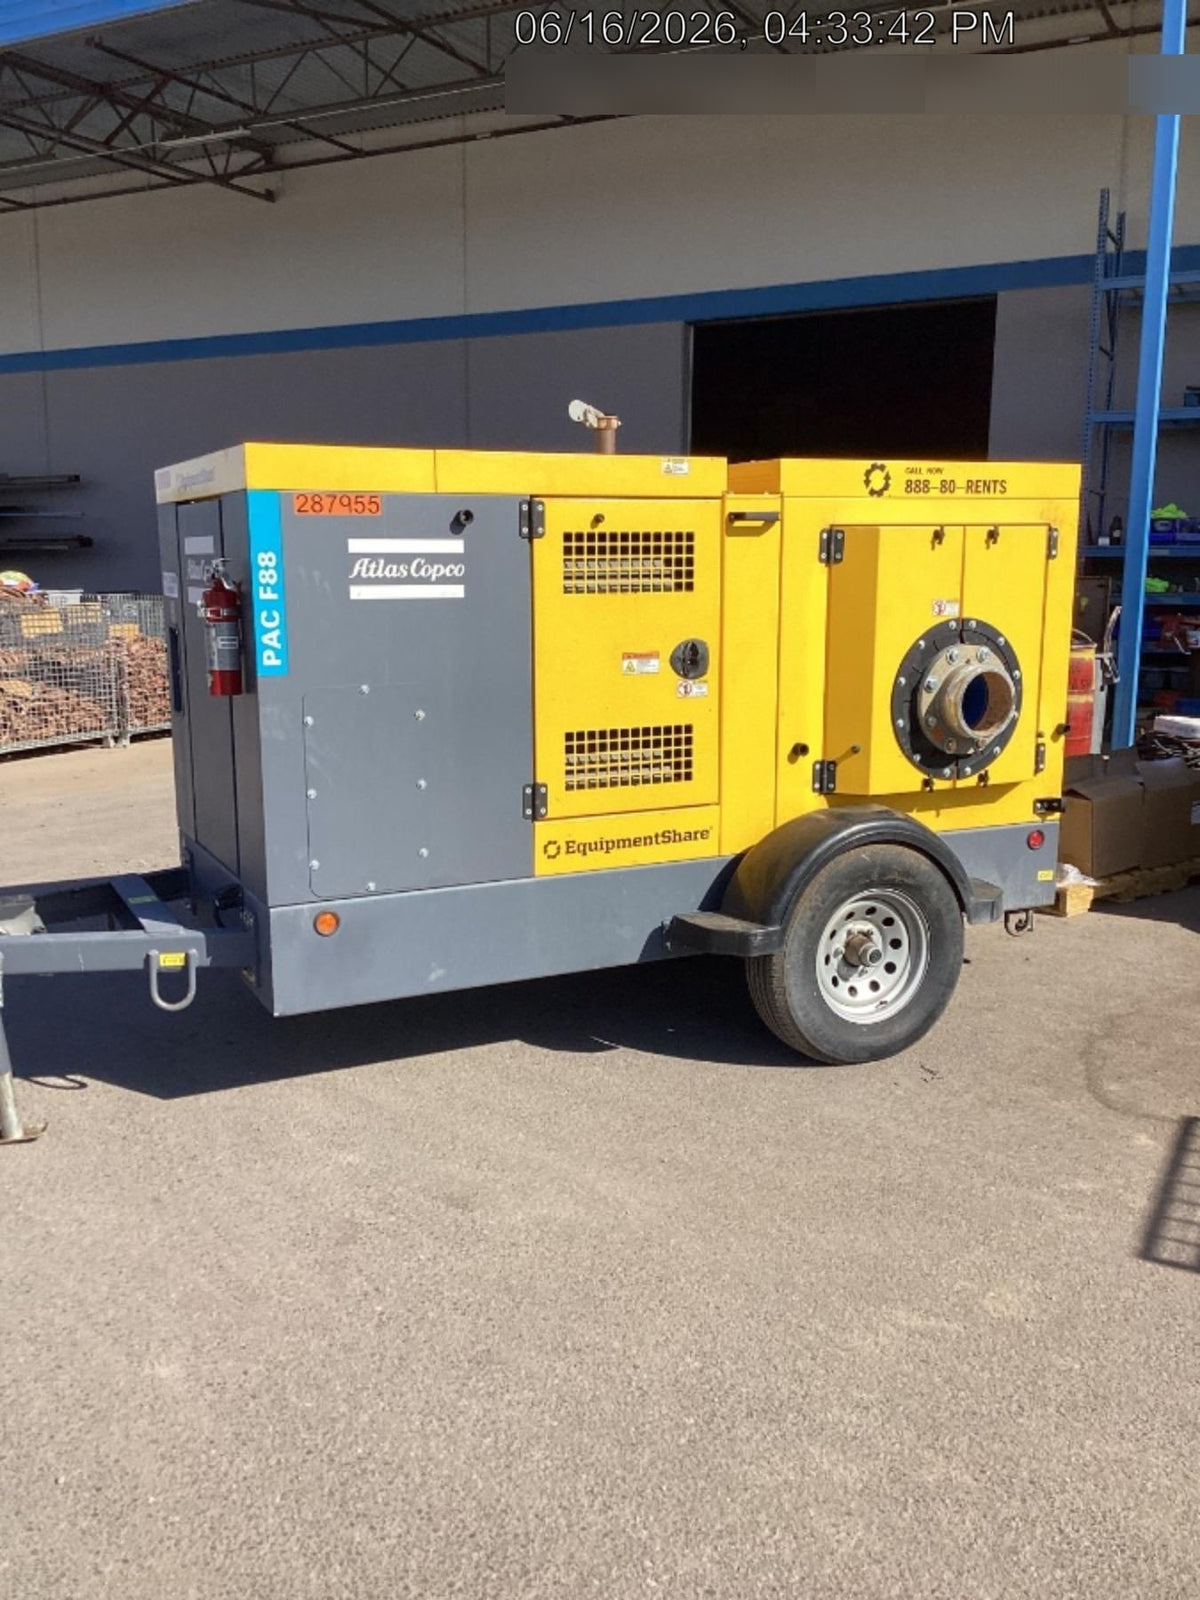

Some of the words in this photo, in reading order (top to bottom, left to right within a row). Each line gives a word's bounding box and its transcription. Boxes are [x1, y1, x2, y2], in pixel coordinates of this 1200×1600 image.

[904, 467, 922, 475] CALL
[295, 494, 381, 515] 287955
[257, 551, 280, 600] F88
[260, 610, 283, 667] PAC
[564, 827, 711, 857] EquipmentShare
